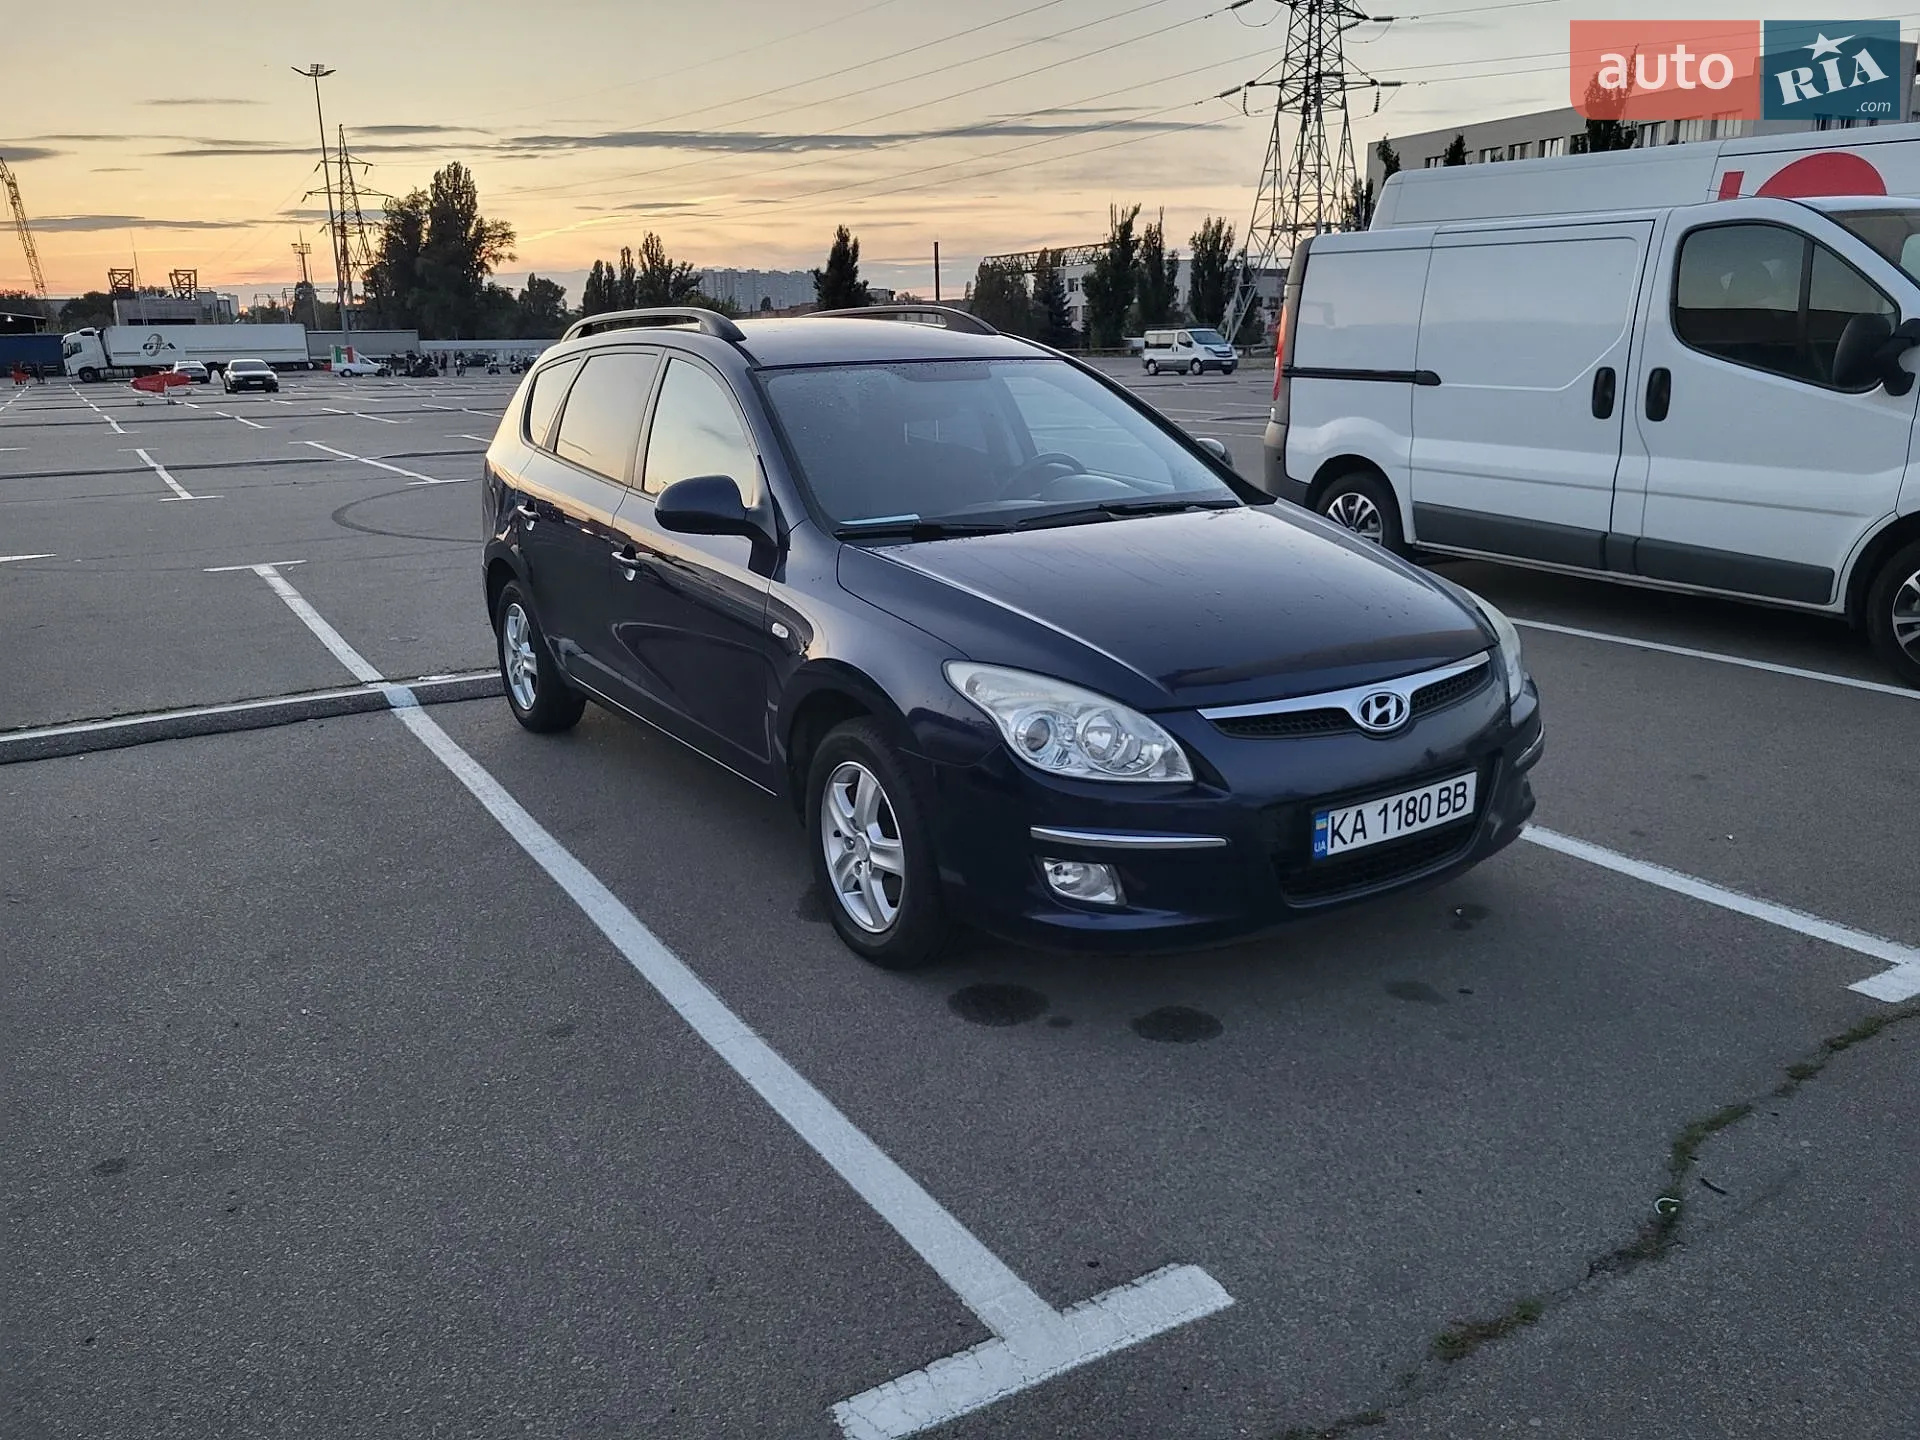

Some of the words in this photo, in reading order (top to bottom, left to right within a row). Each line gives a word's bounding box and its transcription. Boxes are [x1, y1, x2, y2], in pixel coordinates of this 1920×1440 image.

[1330, 808, 1367, 849] KA
[1378, 792, 1431, 834] 1180
[1437, 781, 1467, 818] BB
[1313, 840, 1327, 853] UA
